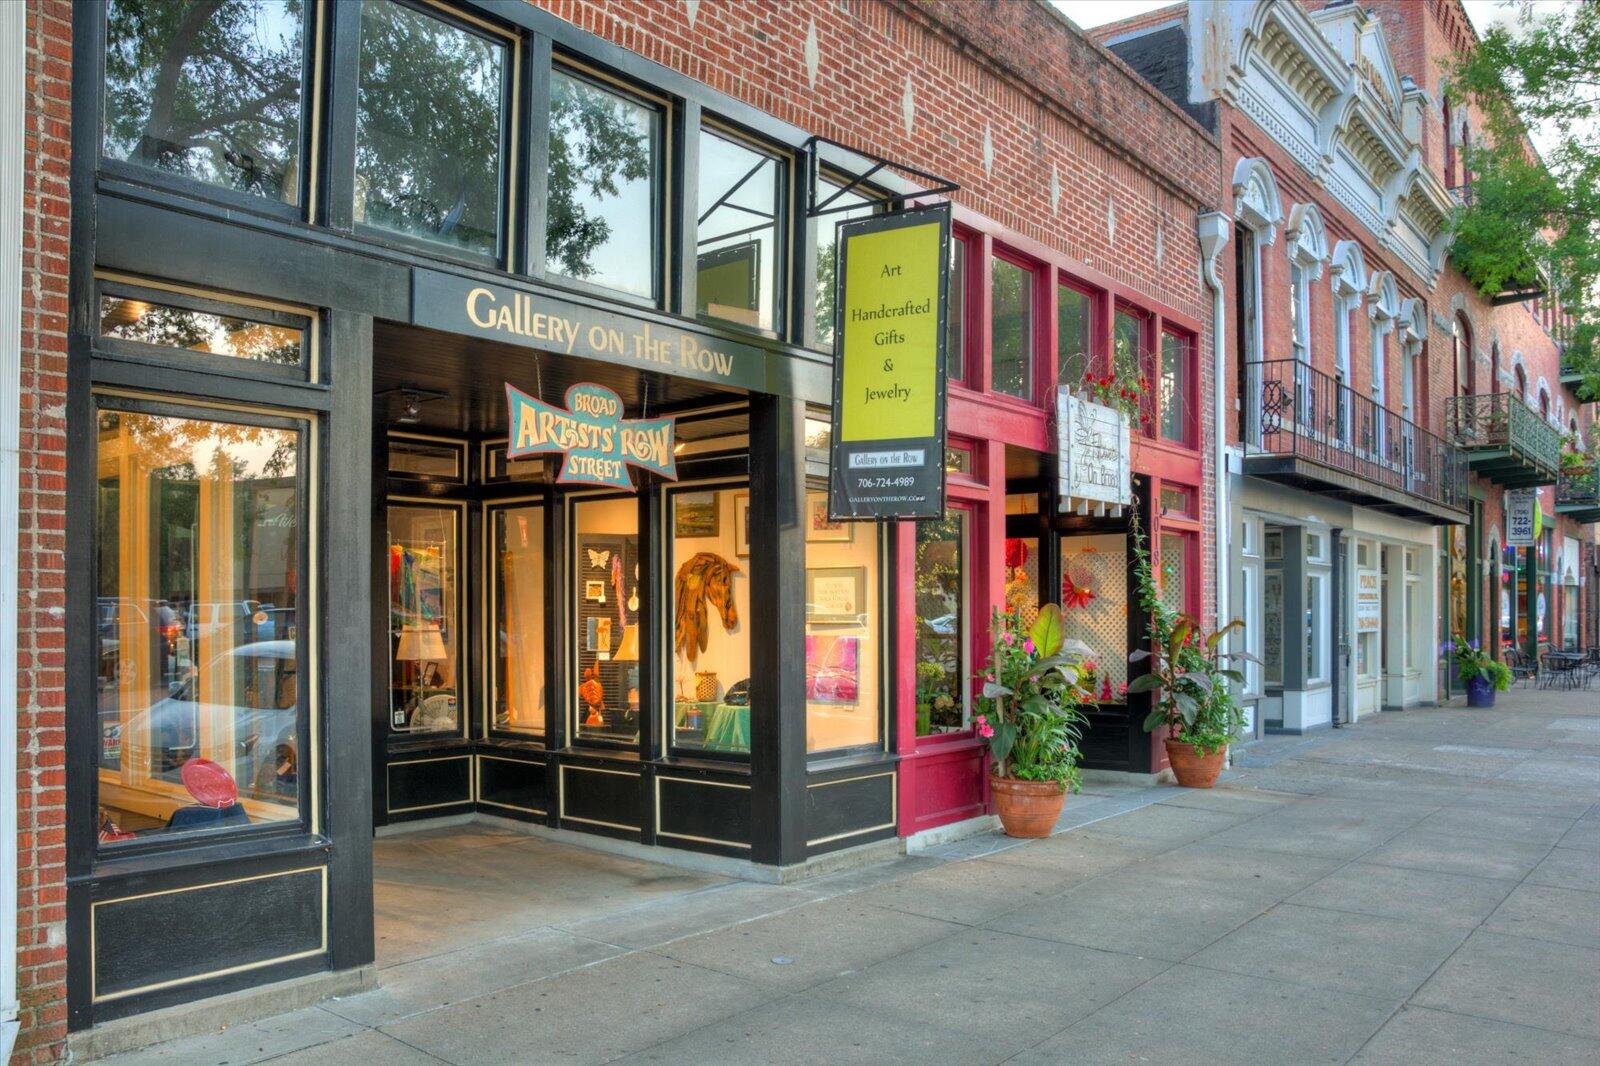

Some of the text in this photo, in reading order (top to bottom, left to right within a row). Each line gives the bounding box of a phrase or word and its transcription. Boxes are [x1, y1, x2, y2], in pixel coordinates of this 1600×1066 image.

[880, 264, 902, 278] Art
[851, 298, 931, 322] Handcrafted
[874, 329, 905, 346] Gifts
[883, 358, 893, 372] &
[864, 383, 912, 404] Jewelry
[574, 392, 617, 418] BROAD
[620, 423, 671, 467] ROW
[568, 455, 622, 481] STREET
[857, 476, 915, 488] 706-724-4989
[1512, 516, 1531, 525] 722-
[1512, 526, 1531, 536] 3961
